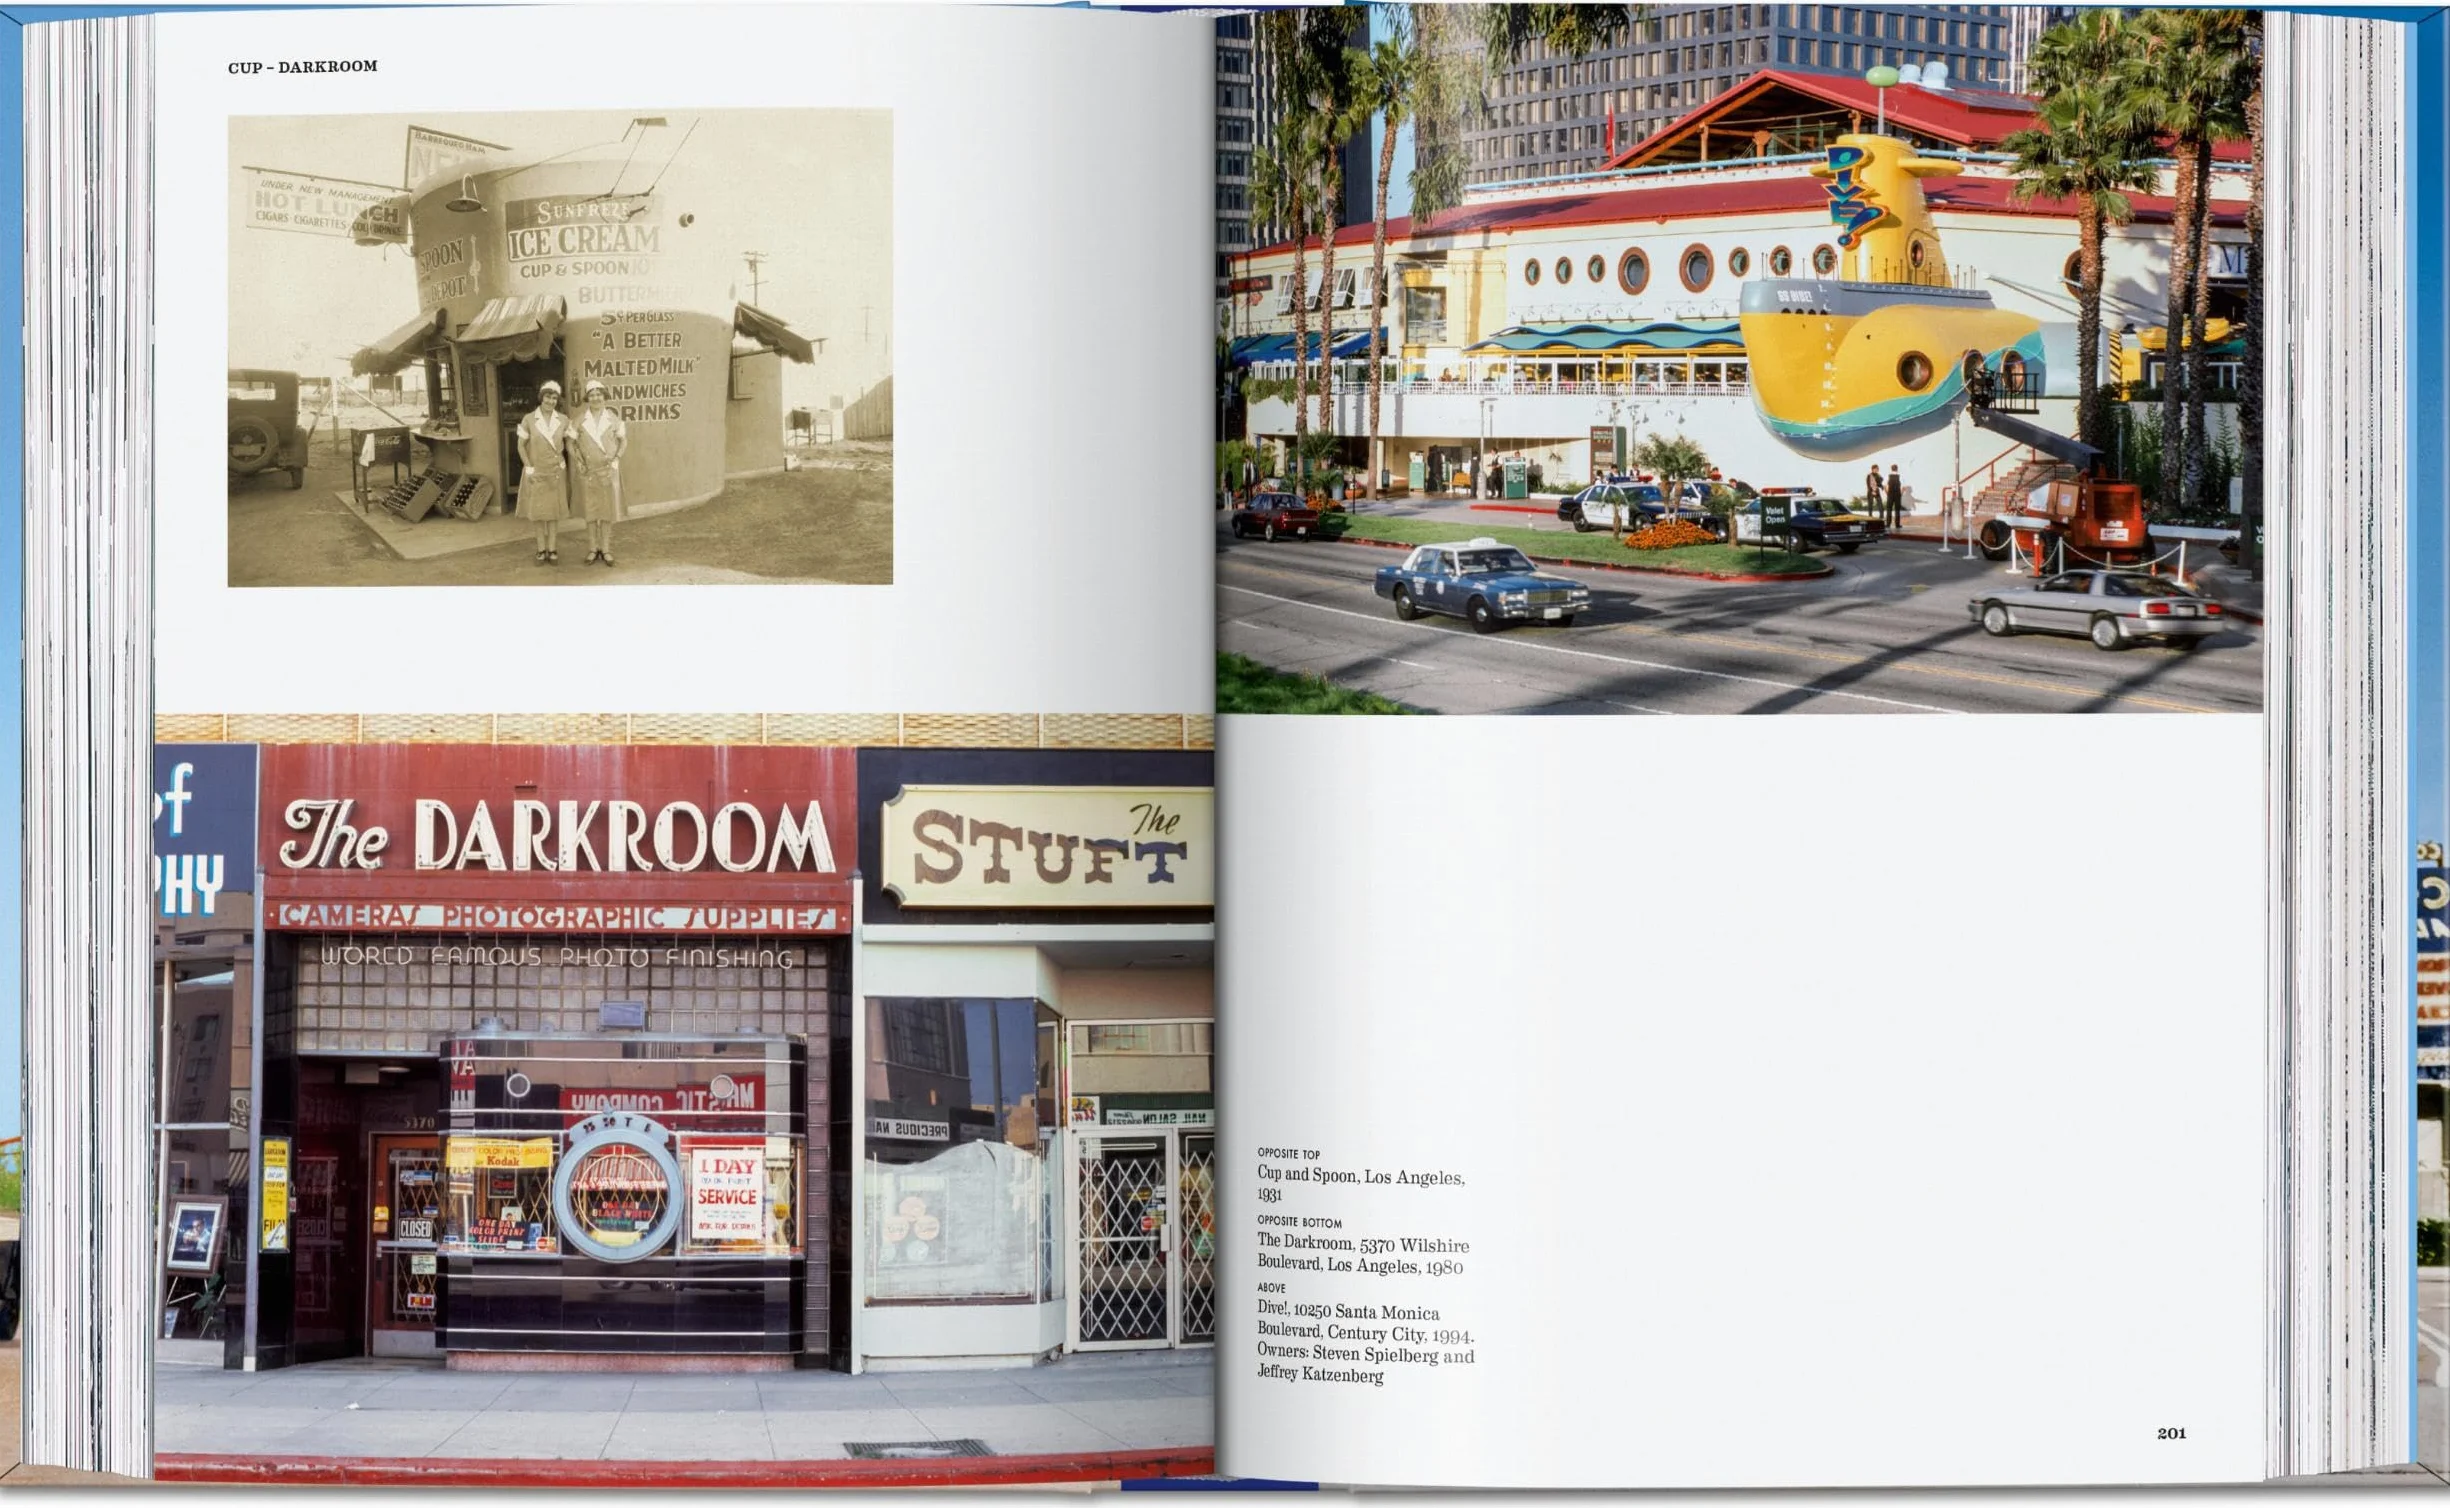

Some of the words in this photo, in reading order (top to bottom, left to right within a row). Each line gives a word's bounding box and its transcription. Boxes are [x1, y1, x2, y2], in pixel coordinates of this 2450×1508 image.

[228, 62, 263, 74] CUP
[278, 60, 378, 73] DARKROOM
[255, 190, 307, 210] HOT
[261, 179, 294, 190] UNDER
[300, 185, 325, 196] NEW
[328, 189, 393, 205] MANAGEMENT
[256, 210, 289, 222] CIGARS
[293, 215, 347, 230] CIGARETTES
[509, 226, 550, 259] ICE
[557, 225, 660, 254] CREAM
[420, 238, 464, 274] SPOON
[520, 264, 551, 279] CUP
[555, 263, 567, 276] &
[572, 262, 629, 275] SPOON
[430, 277, 465, 298] DEPOT
[646, 311, 674, 323] GLASS
[624, 332, 682, 350] BETTER
[584, 359, 657, 378] MALTED
[604, 383, 687, 401] ANDWICHES
[1765, 506, 1784, 515] Valet
[1765, 516, 1786, 524] Open
[1130, 803, 1181, 836] The
[279, 798, 389, 869] The
[415, 798, 837, 873] DARKROOM
[912, 808, 1188, 884] STUFT
[283, 904, 421, 927] CAMERAS
[443, 905, 665, 929] PHOTOGRAPHIC
[684, 907, 830, 930] SUPPLIES
[321, 946, 413, 965] WORLD
[431, 946, 541, 966] FAMOUS
[560, 948, 650, 968] PHOTO
[666, 948, 793, 969] FINISHING
[487, 1156, 519, 1166] Kodak
[1257, 1147, 1299, 1159] OPPOSITE
[1303, 1150, 1320, 1160] TOP
[714, 1159, 757, 1174] DAY
[1257, 1164, 1282, 1182] Cup
[1285, 1167, 1309, 1182] and
[1312, 1167, 1361, 1185] Spoon,
[1364, 1169, 1392, 1184] Los
[1396, 1169, 1466, 1188] Angeles,
[698, 1188, 757, 1205] SERVICE
[1258, 1188, 1282, 1203] 1931
[400, 1219, 432, 1238] CLOSED
[1257, 1214, 1298, 1227] OPPOSITE
[1302, 1217, 1342, 1229] BOTTOM
[1257, 1231, 1281, 1247] The
[1284, 1233, 1356, 1252] Darkroom,
[1360, 1239, 1395, 1254] 5370
[1400, 1237, 1470, 1253] Wilshire
[1257, 1252, 1324, 1272] Boulevard,
[1328, 1257, 1352, 1272] Los
[1356, 1257, 1422, 1277] Angeles,
[1426, 1260, 1463, 1277] 1980
[1257, 1282, 1286, 1293] ABOVE
[1257, 1299, 1291, 1316] Dive!,
[1294, 1304, 1332, 1319] 10250
[1335, 1304, 1377, 1320] Santa
[1381, 1305, 1440, 1321] Monica
[1257, 1320, 1324, 1339] Boulevard,
[1328, 1324, 1387, 1344] Century
[1392, 1327, 1428, 1345] City,
[1432, 1329, 1475, 1344] 1994.
[1257, 1341, 1309, 1359] Owners:
[1312, 1344, 1360, 1361] Steven
[1364, 1346, 1439, 1366] Spielberg
[1443, 1349, 1475, 1364] and
[1257, 1363, 1299, 1383] Jeffrey
[1302, 1366, 1384, 1386] Katzenberg
[2157, 1427, 2187, 1440] 201
